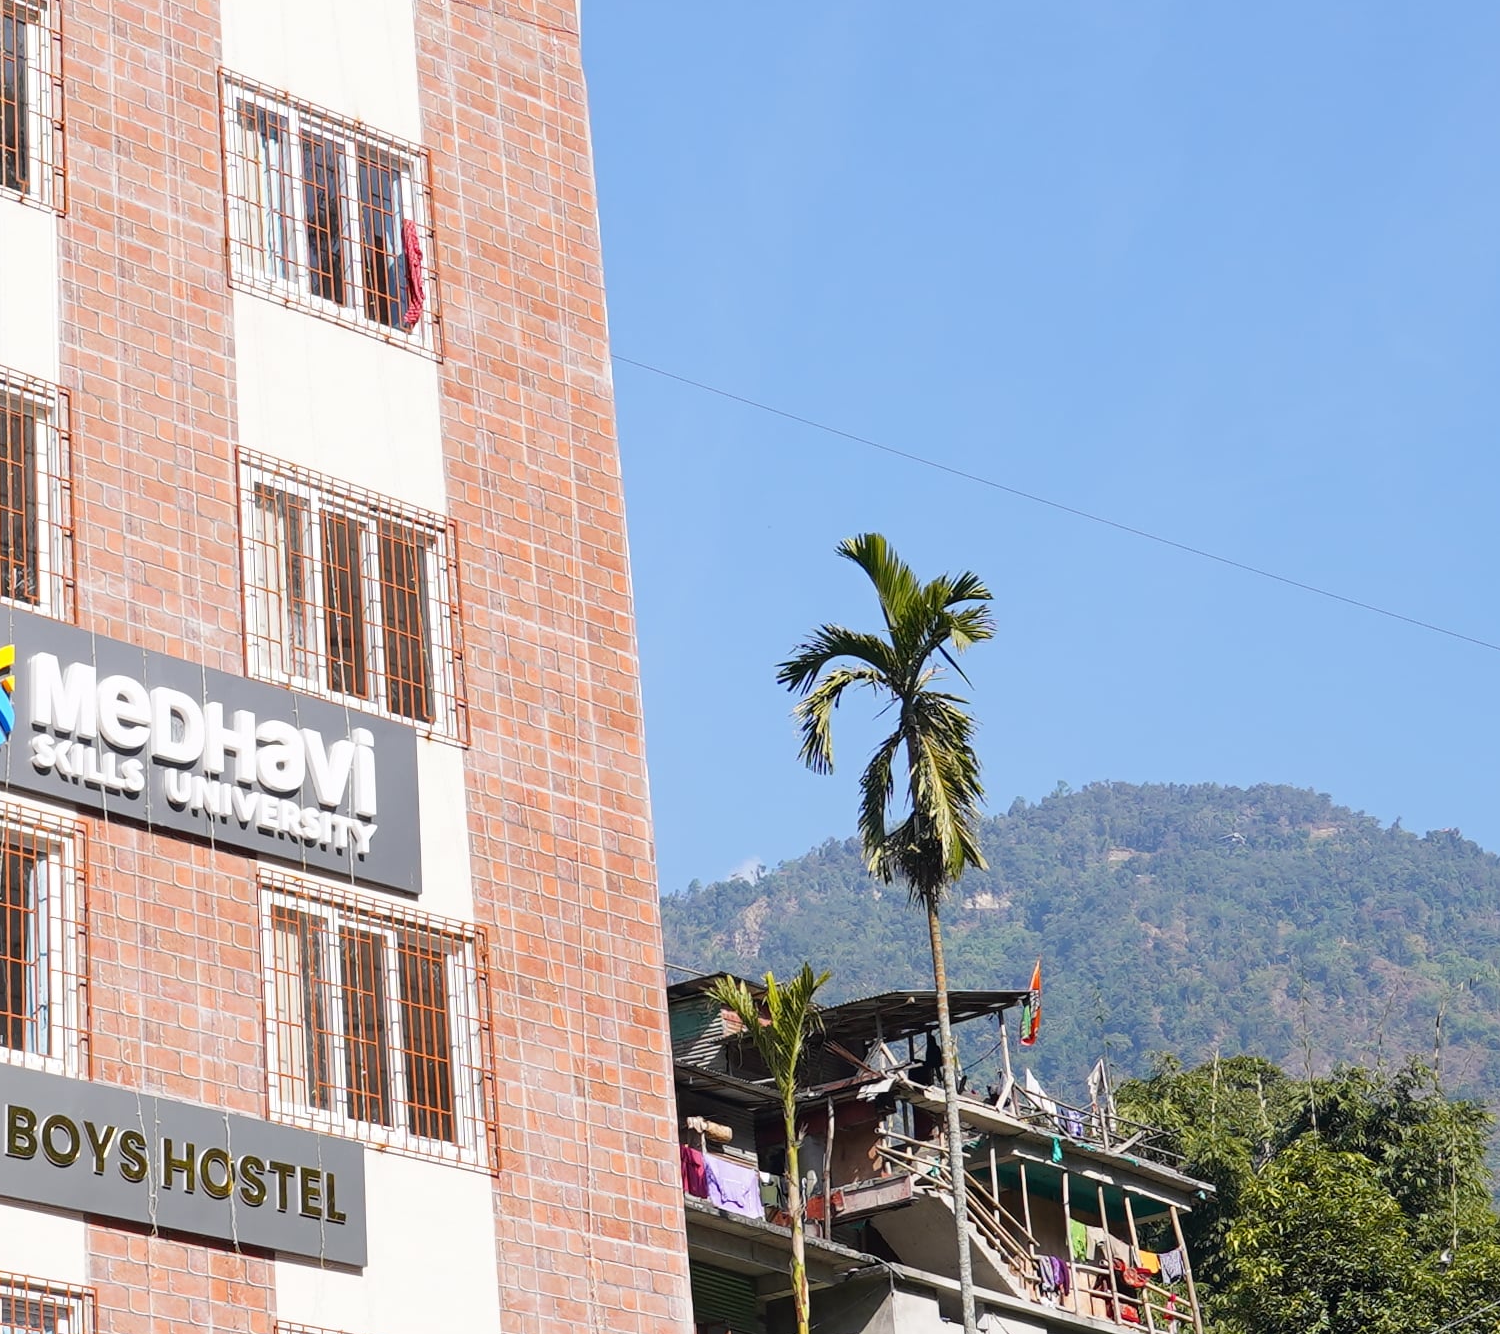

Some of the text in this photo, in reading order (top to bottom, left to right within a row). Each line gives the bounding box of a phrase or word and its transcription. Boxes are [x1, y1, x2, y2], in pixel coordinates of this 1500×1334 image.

[31, 734, 378, 855] SKILLS UNIVERSITY
[4, 1103, 347, 1224] BOYS HOSTEL
